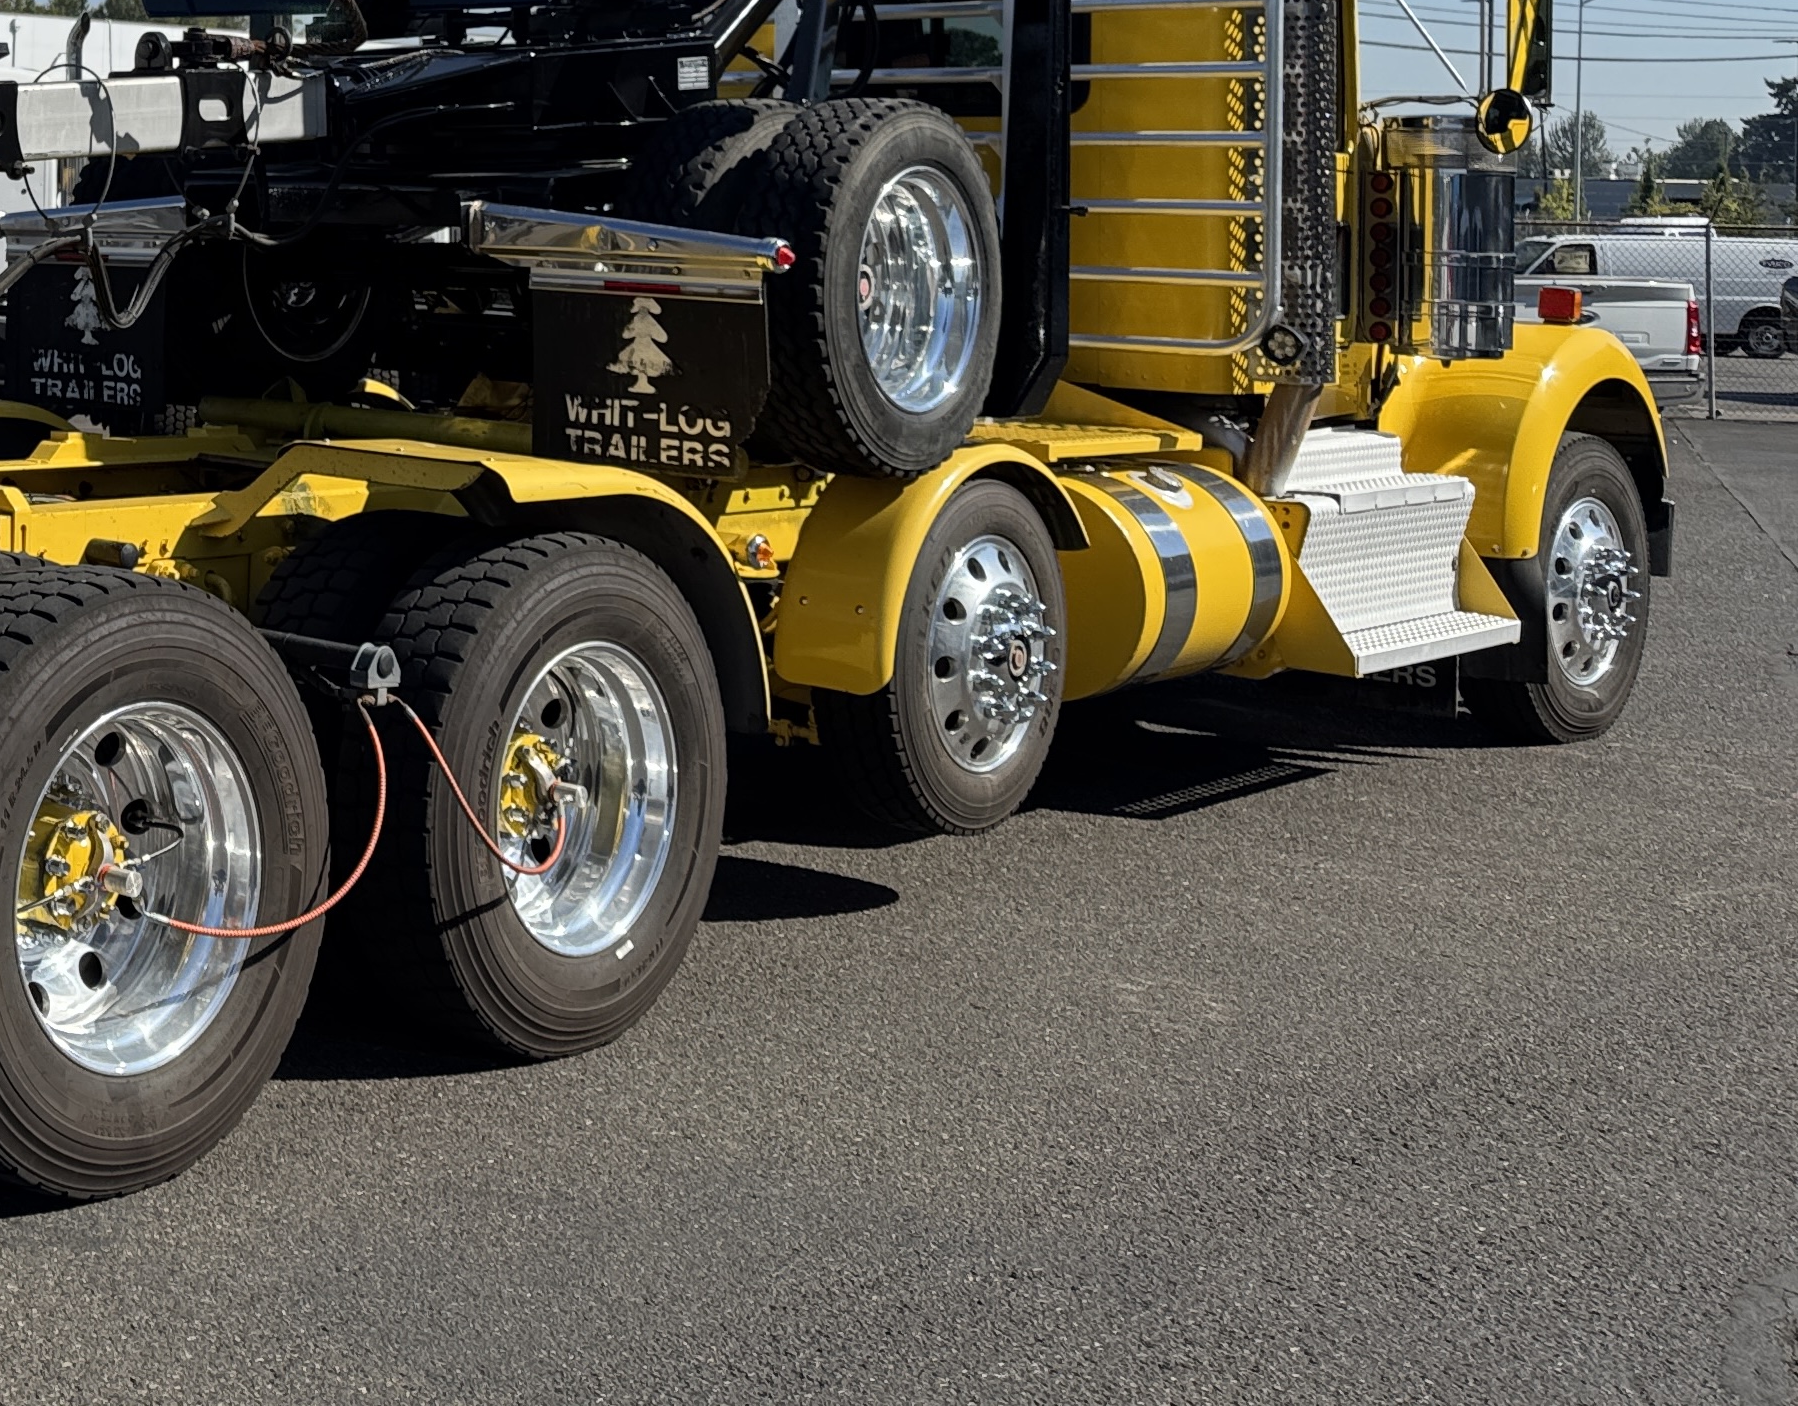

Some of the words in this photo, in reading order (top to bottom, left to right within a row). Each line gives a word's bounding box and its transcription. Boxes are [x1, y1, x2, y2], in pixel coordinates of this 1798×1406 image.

[564, 394, 731, 439] WHIT-LOG
[564, 428, 731, 468] TRAILERS
[247, 698, 304, 856] BFGoodrich
[474, 719, 501, 884] BFoodrich
